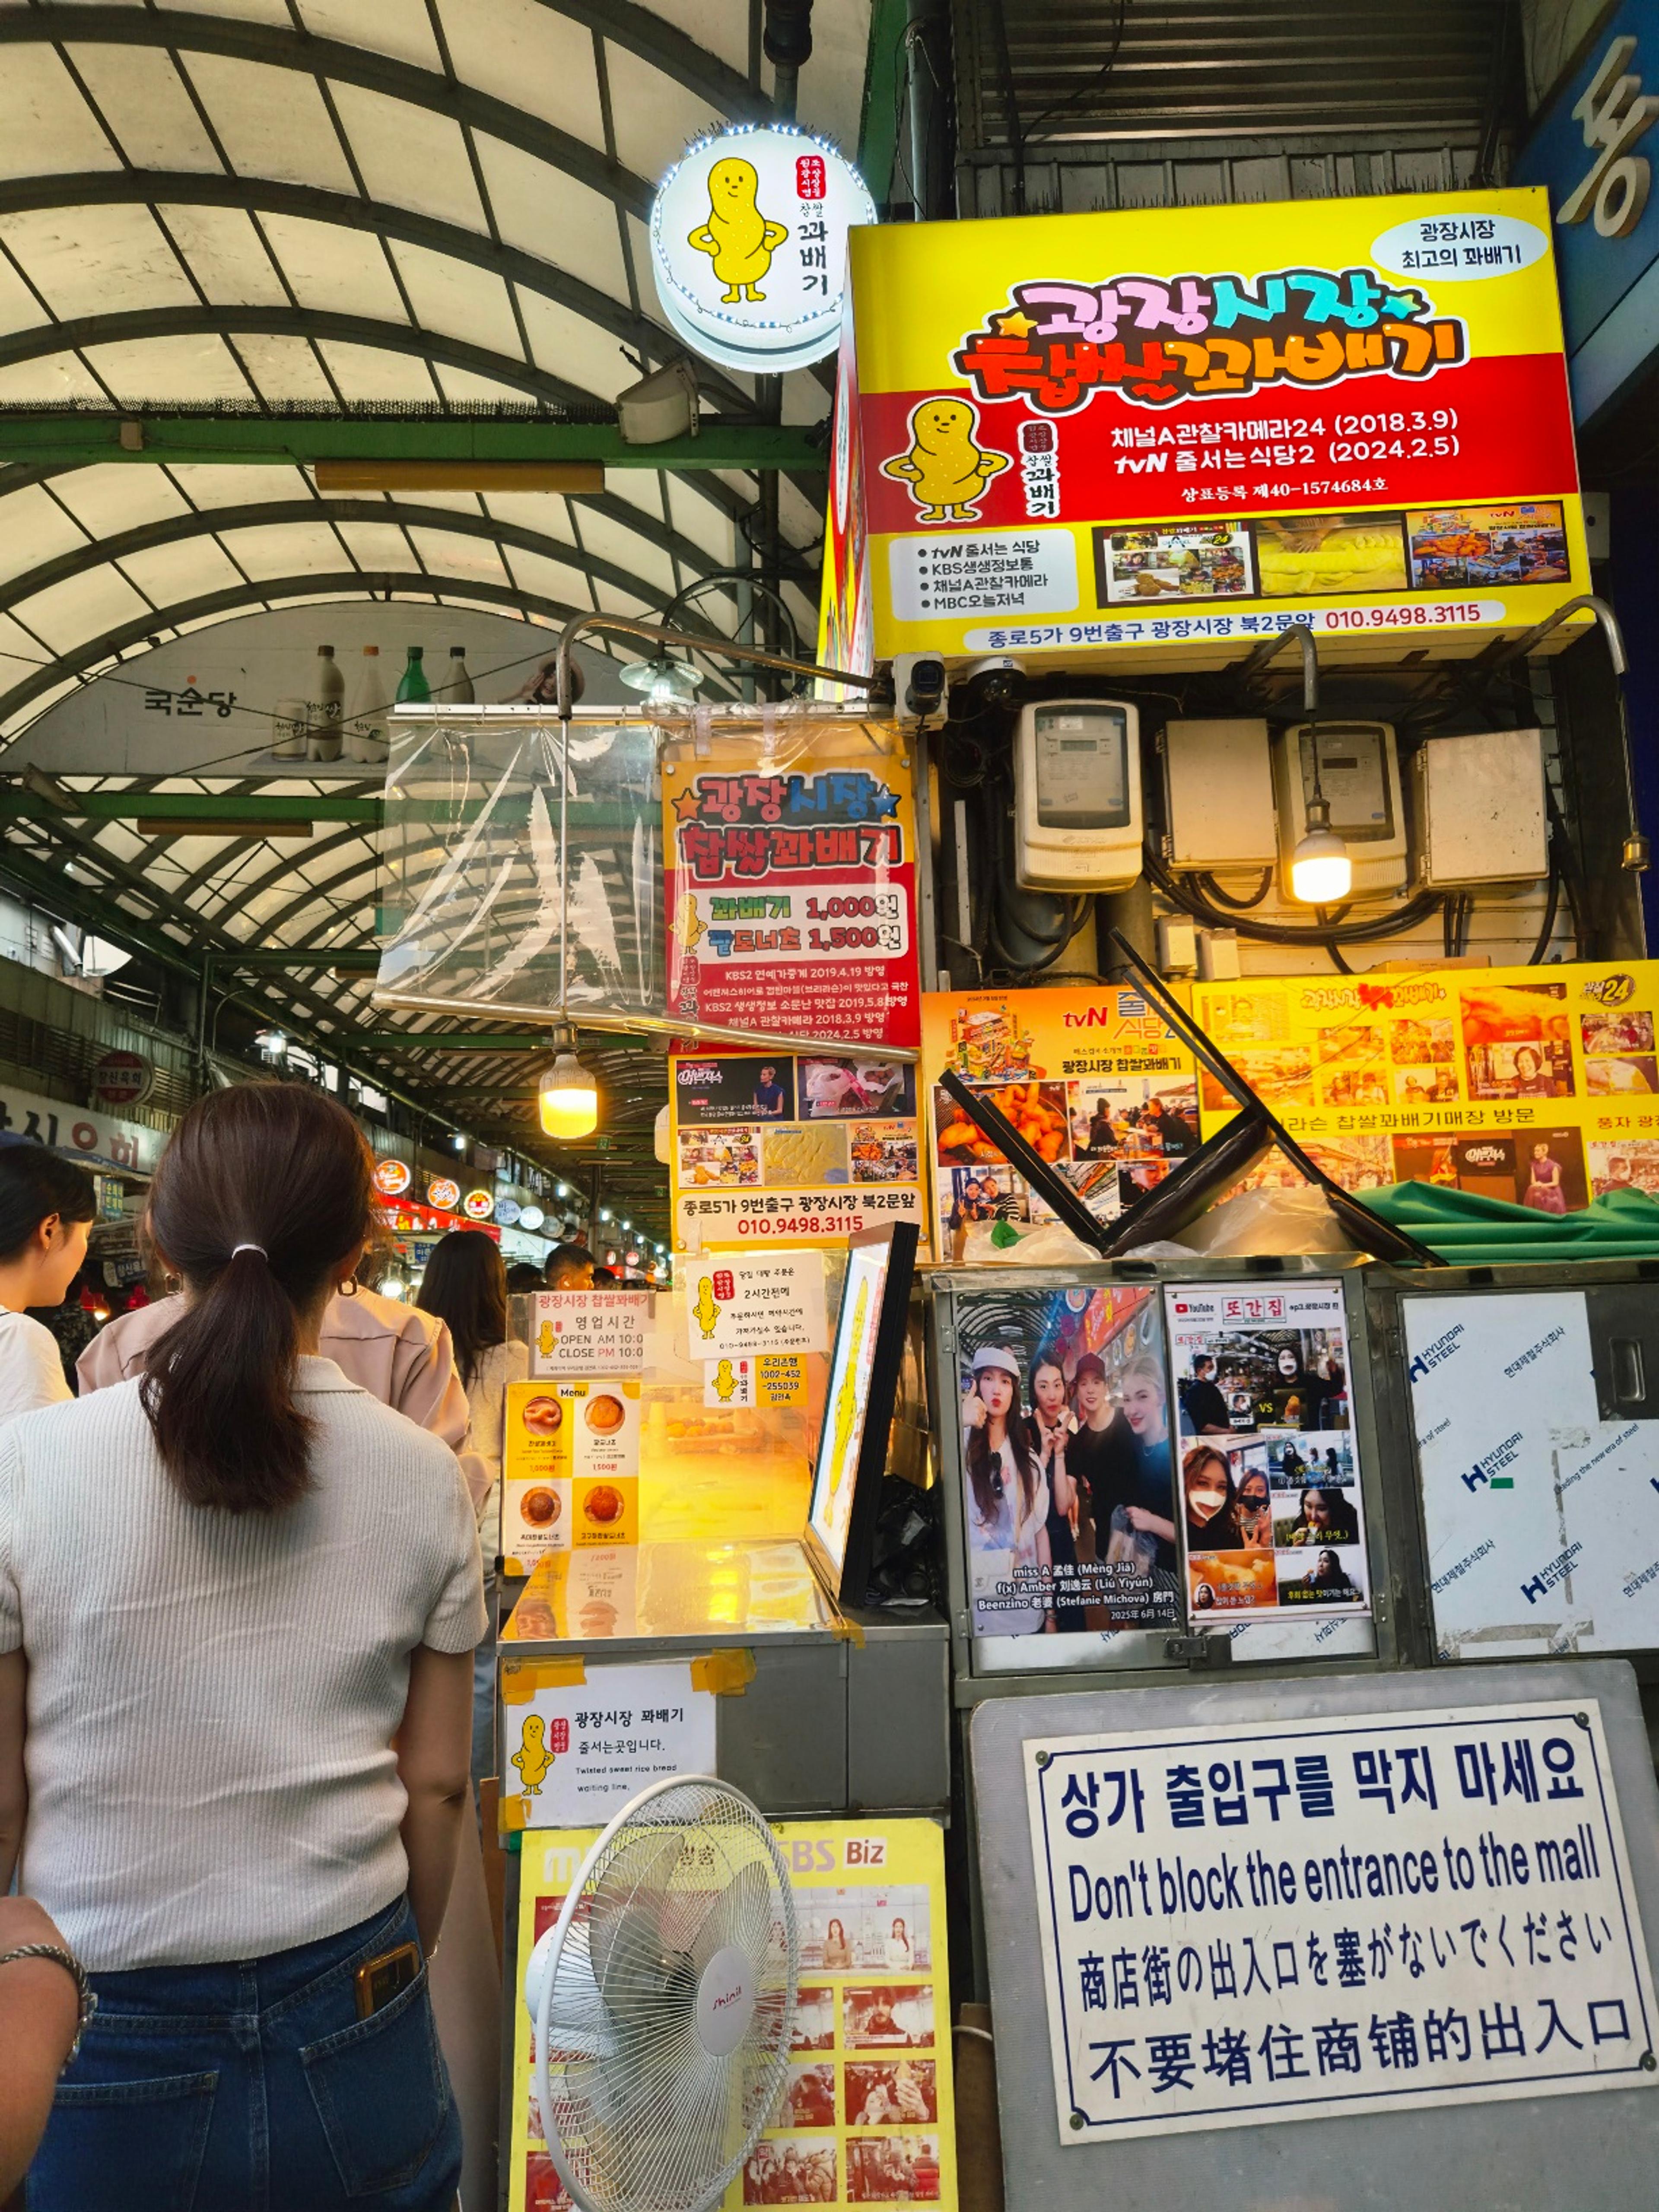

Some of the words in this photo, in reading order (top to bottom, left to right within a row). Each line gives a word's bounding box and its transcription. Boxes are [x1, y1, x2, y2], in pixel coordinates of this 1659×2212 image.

[1421, 220, 1496, 242] 광장시장
[1402, 248, 1458, 269] 최고의
[1465, 244, 1521, 265] 꽈배기
[1021, 274, 1382, 343] 광장시장
[1112, 420, 1326, 448] 채널A관찰카메라24
[1335, 408, 1459, 436] (2018.3.9)
[1115, 452, 1168, 474] tvN
[1328, 435, 1460, 464] (2024.2.5)
[1026, 467, 1055, 515] 꽈배기
[1181, 486, 1247, 503] 상표등록
[1253, 477, 1388, 499] 제40-1574684호
[931, 545, 963, 560] tvN
[966, 543, 1008, 559] 줄서는
[1012, 539, 1040, 555] 식당
[932, 557, 1033, 576] KBS생생정보통
[934, 574, 1049, 594] 채널A관찰카메라
[934, 592, 1025, 610] MBC오늘저녁
[988, 627, 1063, 648] 종로5가
[1070, 622, 1145, 643] 9번출구
[1151, 616, 1233, 639] 광장시장
[1241, 609, 1316, 634] 북2문앞
[1326, 603, 1481, 630] 010.9498.3115
[144, 688, 237, 718] 국순당
[702, 775, 874, 822] 광장시장
[680, 826, 899, 875] 찹쌀꽈배기
[710, 896, 791, 921] 꽈배기
[806, 893, 899, 922] 1,000원
[809, 925, 901, 951] 1,500원
[725, 970, 753, 981] KBS2
[755, 968, 807, 980] 연예가중계
[810, 966, 862, 978] 2019.4.19
[864, 965, 885, 977] 방영
[705, 1002, 732, 1012] KBS2
[734, 1000, 777, 1013] 생생정보
[780, 998, 812, 1011] 소문난
[814, 998, 836, 1010] 맛집
[839, 997, 884, 1008] 2019.5.8
[728, 1016, 757, 1028] 채널A
[760, 1015, 814, 1027] 관찰카메라
[816, 1014, 862, 1024] 2018.3.9
[864, 1012, 885, 1023] 방영
[1063, 1007, 1108, 1027] tvN
[862, 1027, 884, 1039] 방영
[1062, 1059, 1113, 1074] 광장시장
[1116, 1057, 1182, 1072] 찹쌀꽈배기
[1494, 1109, 1535, 1125] 방문
[1597, 1116, 1631, 1130] 풍자
[683, 1198, 737, 1217] 종로5가
[741, 1195, 795, 1214] 9번출구
[798, 1194, 858, 1213] 광장시장
[861, 1192, 915, 1210] 북2문앞
[737, 1215, 864, 1235] 010.9498.3115
[774, 1267, 795, 1277] 주문은
[539, 1294, 588, 1309] 광장시장
[744, 1287, 790, 1299] 2시간전에
[1189, 1302, 1214, 1313] YouTube
[1226, 1298, 1282, 1317] 또간집
[773, 1324, 805, 1333] 있습니다.
[561, 1335, 591, 1344] OPEN
[597, 1335, 615, 1344] AM
[1421, 1324, 1465, 1360] HYUNDAI
[559, 1348, 595, 1358] CLOSE
[597, 1348, 615, 1357] PM
[763, 1357, 798, 1367] 우리은행
[1428, 1342, 1461, 1369] STEEL
[1503, 1325, 1566, 1379] 현대제철주식회사
[760, 1370, 801, 1379] 1002-452
[560, 1389, 586, 1397] Menu
[762, 1382, 799, 1391] -255039
[1259, 1403, 1274, 1414] VS
[1427, 1430, 1435, 1440] of
[1434, 1418, 1451, 1435] steel
[1480, 1431, 1524, 1468] HYUNDAI
[1579, 1463, 1592, 1477] the
[1591, 1452, 1606, 1466] new
[1604, 1442, 1617, 1454] era
[1615, 1434, 1624, 1446] of
[1622, 1423, 1640, 1440] steel
[1486, 1451, 1519, 1478] STEEL
[1430, 1539, 1496, 1594] 현대제철주식회사
[1538, 1541, 1583, 1580] HYUNDAI
[1013, 1567, 1039, 1578] miss
[1042, 1564, 1050, 1576] A
[1052, 1564, 1075, 1577] 孟佳
[1546, 1560, 1579, 1589] STEEL
[995, 1582, 1017, 1595] f(x)
[1020, 1581, 1057, 1593] Amber
[1095, 1578, 1115, 1590] (Liú
[978, 1598, 1029, 1611] Beenzino
[1031, 1596, 1053, 1609] 老婆
[1056, 1595, 1101, 1608] (Stefanie
[1103, 1592, 1149, 1605] Michova)
[1111, 1609, 1139, 1621] 2025年
[1141, 1609, 1155, 1619] 6月
[1157, 1608, 1175, 1618] 14日
[574, 1709, 633, 1728] 광장시장
[641, 1707, 684, 1724] 꽈배기
[578, 1739, 665, 1755] 줄서는곳입니다.
[576, 1766, 607, 1774] Twisted
[653, 1764, 677, 1772] bread
[577, 1783, 609, 1792] waiting
[1060, 1767, 1145, 1839] 상가
[1166, 1754, 1335, 1829] 출입구를
[1352, 1745, 1439, 1813] 막지
[1453, 1736, 1585, 1806] 마세요
[846, 1839, 885, 1865] Biz
[1068, 1862, 1149, 1923] Don't
[1160, 1851, 1240, 1915] block
[1245, 1848, 1297, 1908] the
[1304, 1843, 1440, 1902] entrance
[1442, 1836, 1476, 1892] to
[1478, 1830, 1531, 1886] the
[1536, 1822, 1601, 1882] mall
[1077, 1910, 1612, 2013] 商店街の出入口を塞がないでください
[1089, 1998, 1632, 2100] 不要堵住商铺的出入口
